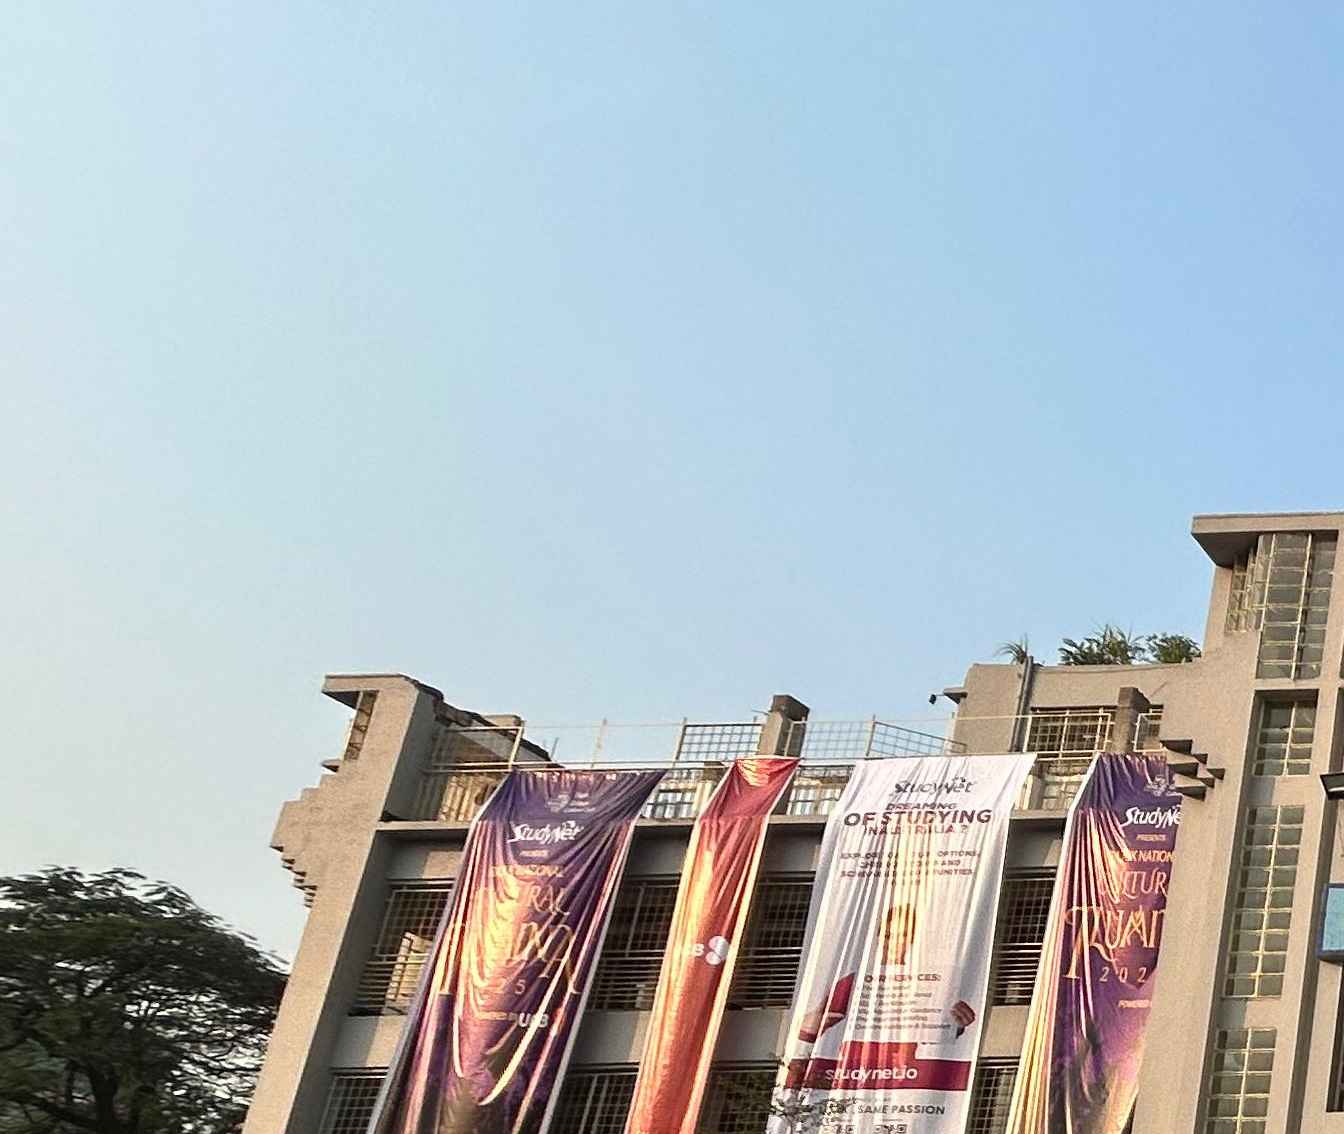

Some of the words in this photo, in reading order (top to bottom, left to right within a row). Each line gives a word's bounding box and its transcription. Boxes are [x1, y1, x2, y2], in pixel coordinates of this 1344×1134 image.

[844, 812, 876, 827] OF
[881, 809, 992, 825] STUDYING
[1120, 805, 1183, 829] StudyNe
[1137, 850, 1176, 862] NATION
[1099, 966, 1147, 983] 202
[891, 1104, 946, 1115] PASSION
